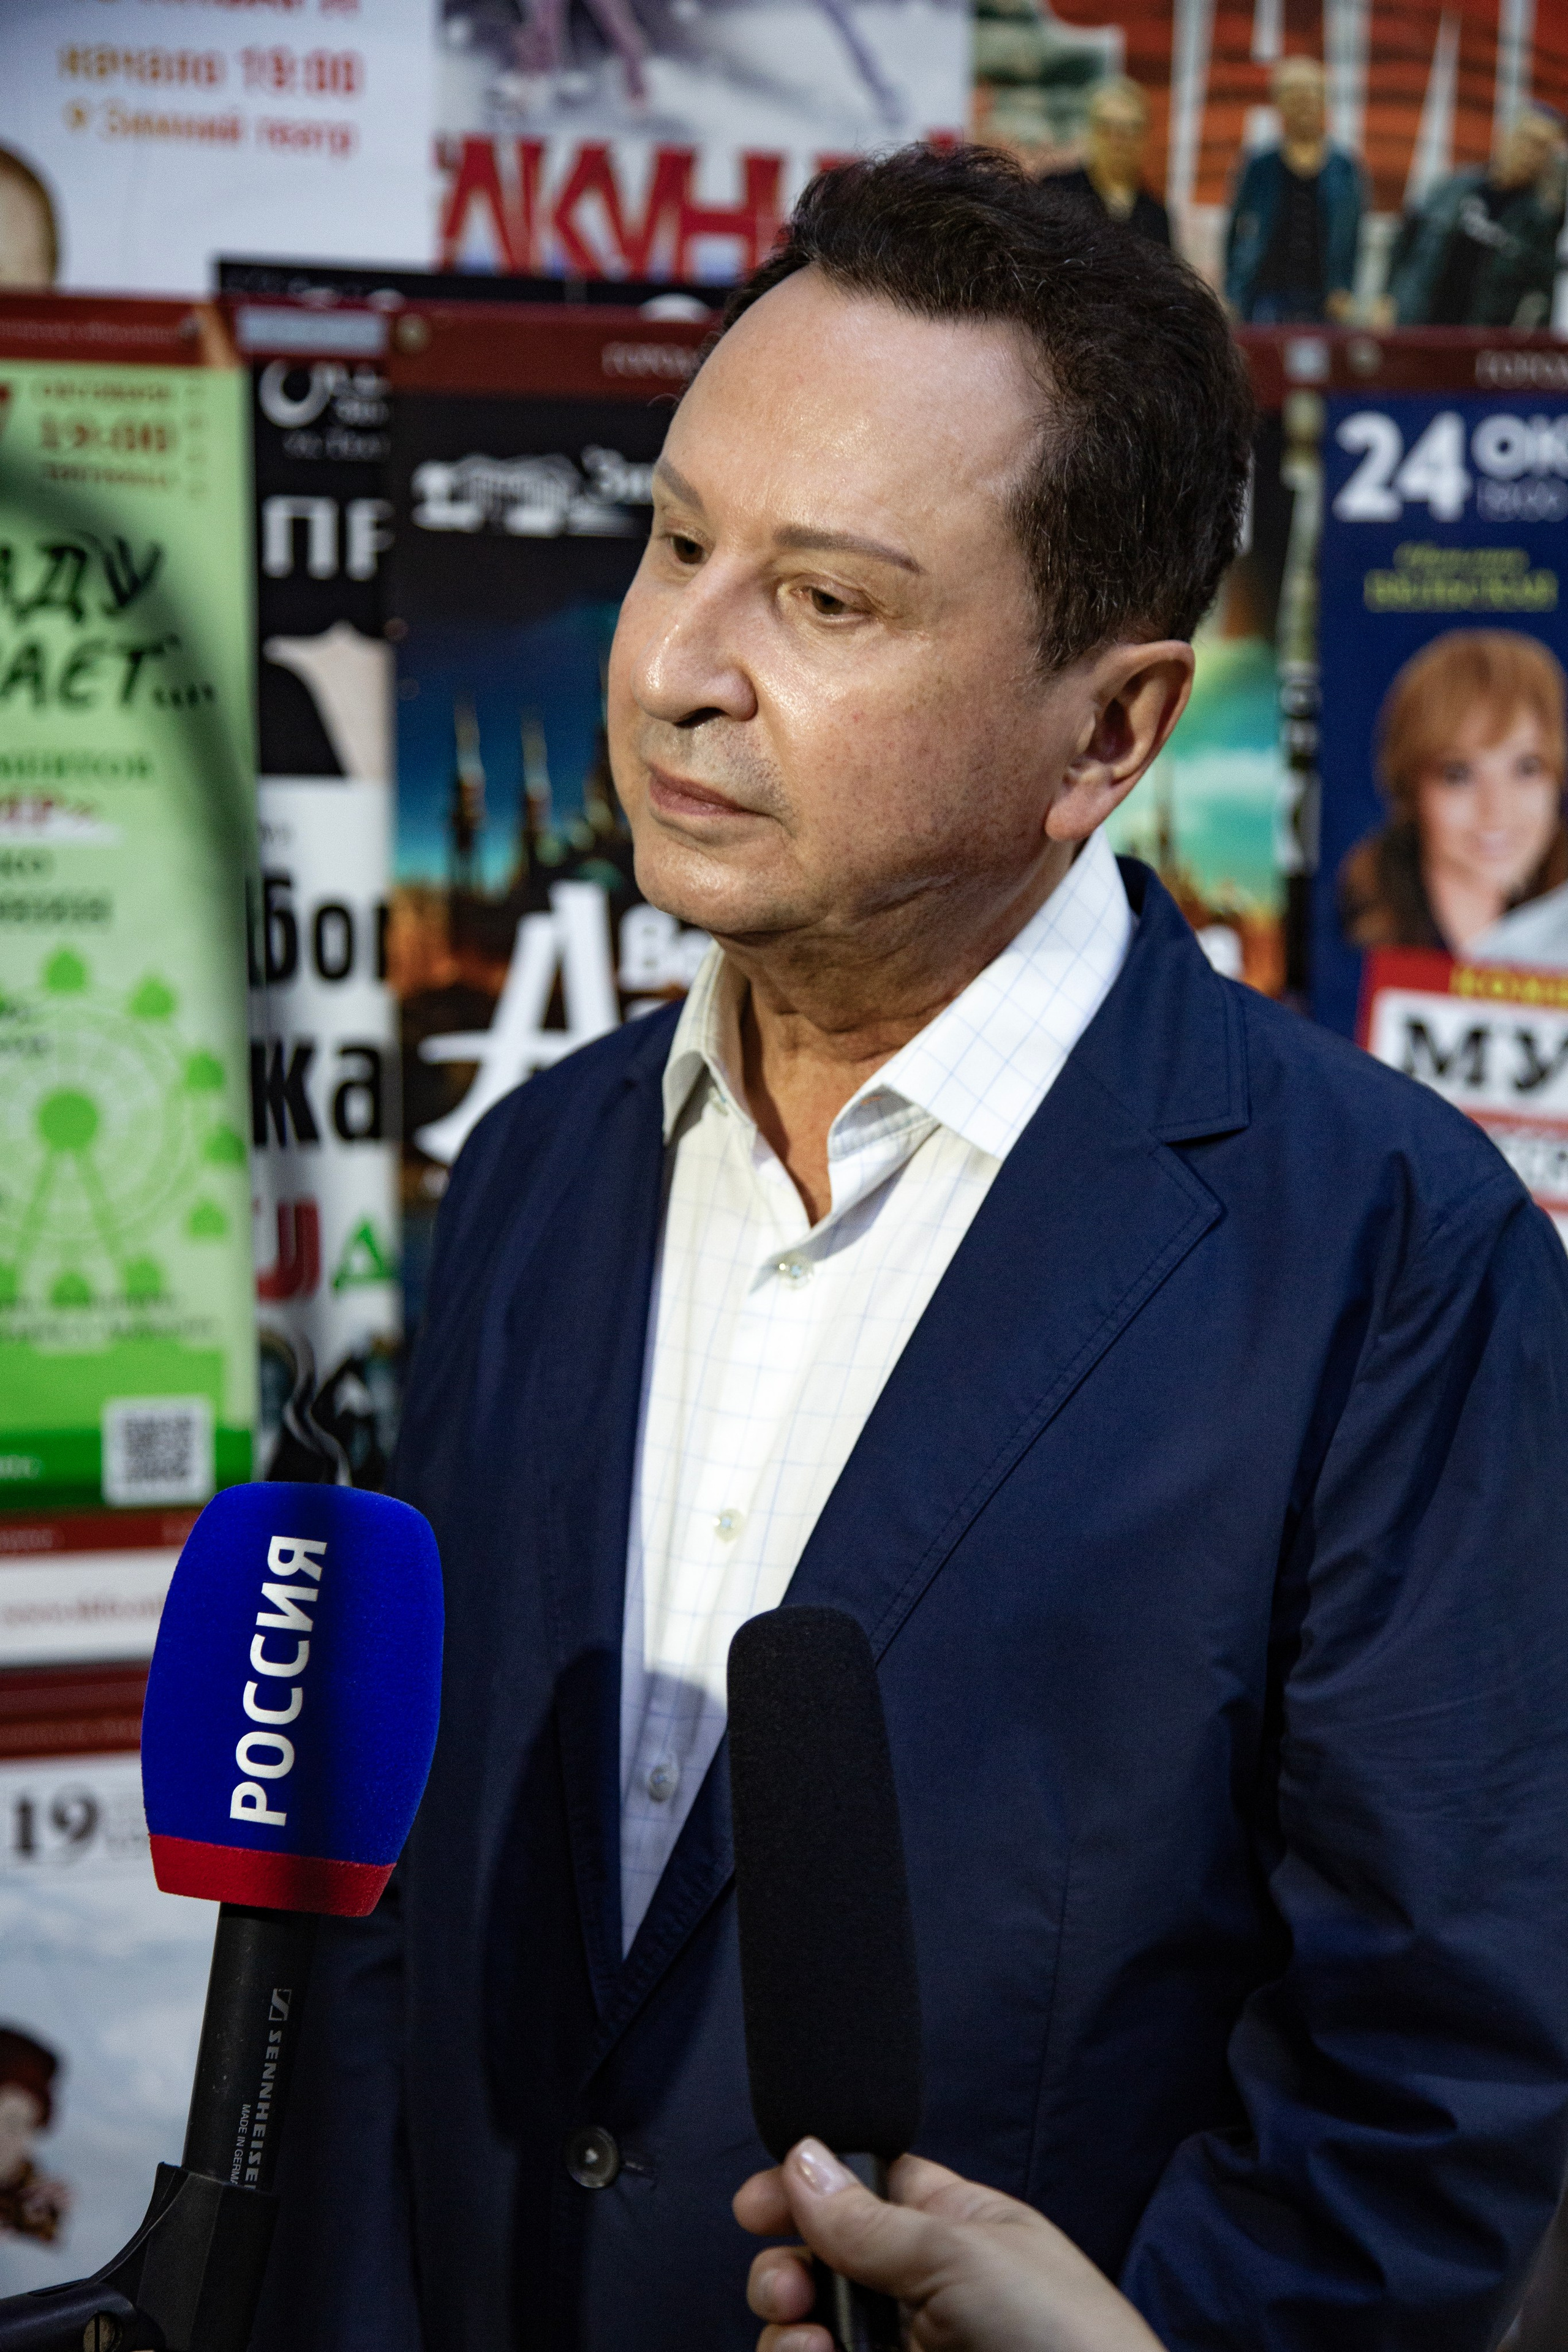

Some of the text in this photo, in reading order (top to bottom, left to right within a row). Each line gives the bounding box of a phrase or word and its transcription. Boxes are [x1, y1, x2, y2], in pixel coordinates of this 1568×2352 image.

[1333, 410, 1471, 522] 24
[230, 1536, 328, 1826] РОССИЯ
[236, 2136, 246, 2147] IN
[238, 2103, 252, 2134] MADE
